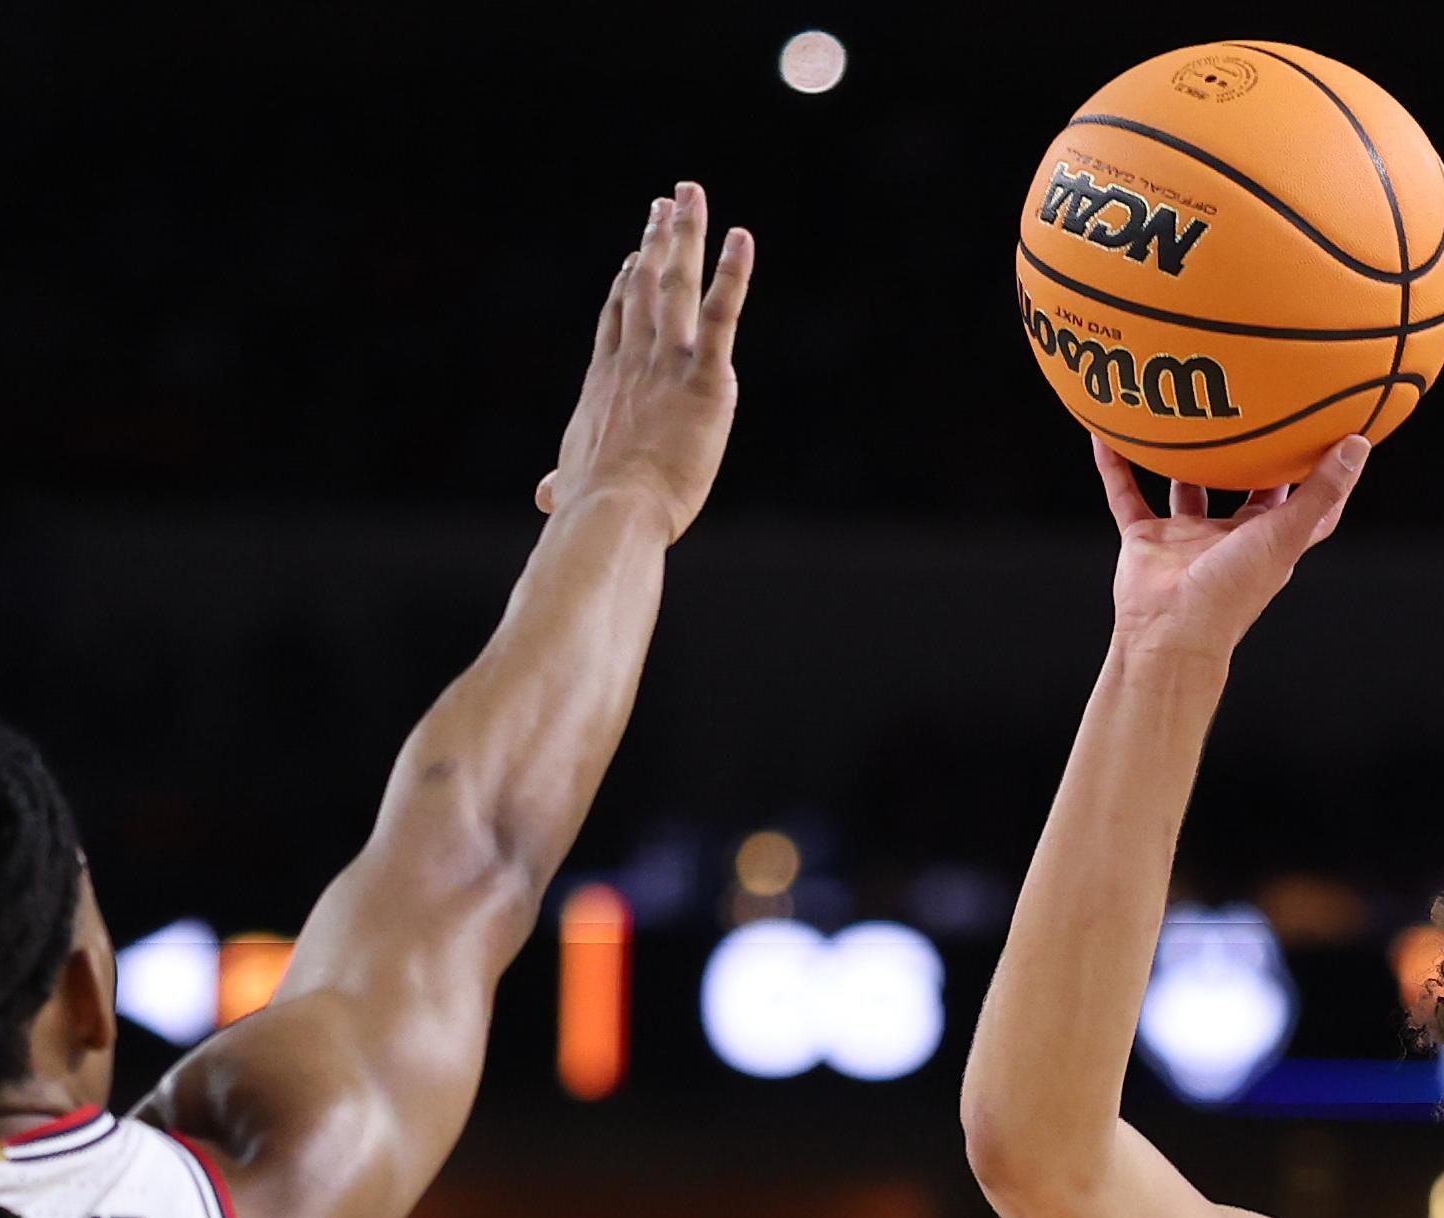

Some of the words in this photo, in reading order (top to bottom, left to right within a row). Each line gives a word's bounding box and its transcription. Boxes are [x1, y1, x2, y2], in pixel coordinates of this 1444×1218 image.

[1038, 161, 1211, 277] NCAA
[1016, 274, 1242, 420] Wilson
[1055, 306, 1084, 329] NXT
[1088, 323, 1122, 341] EVO
